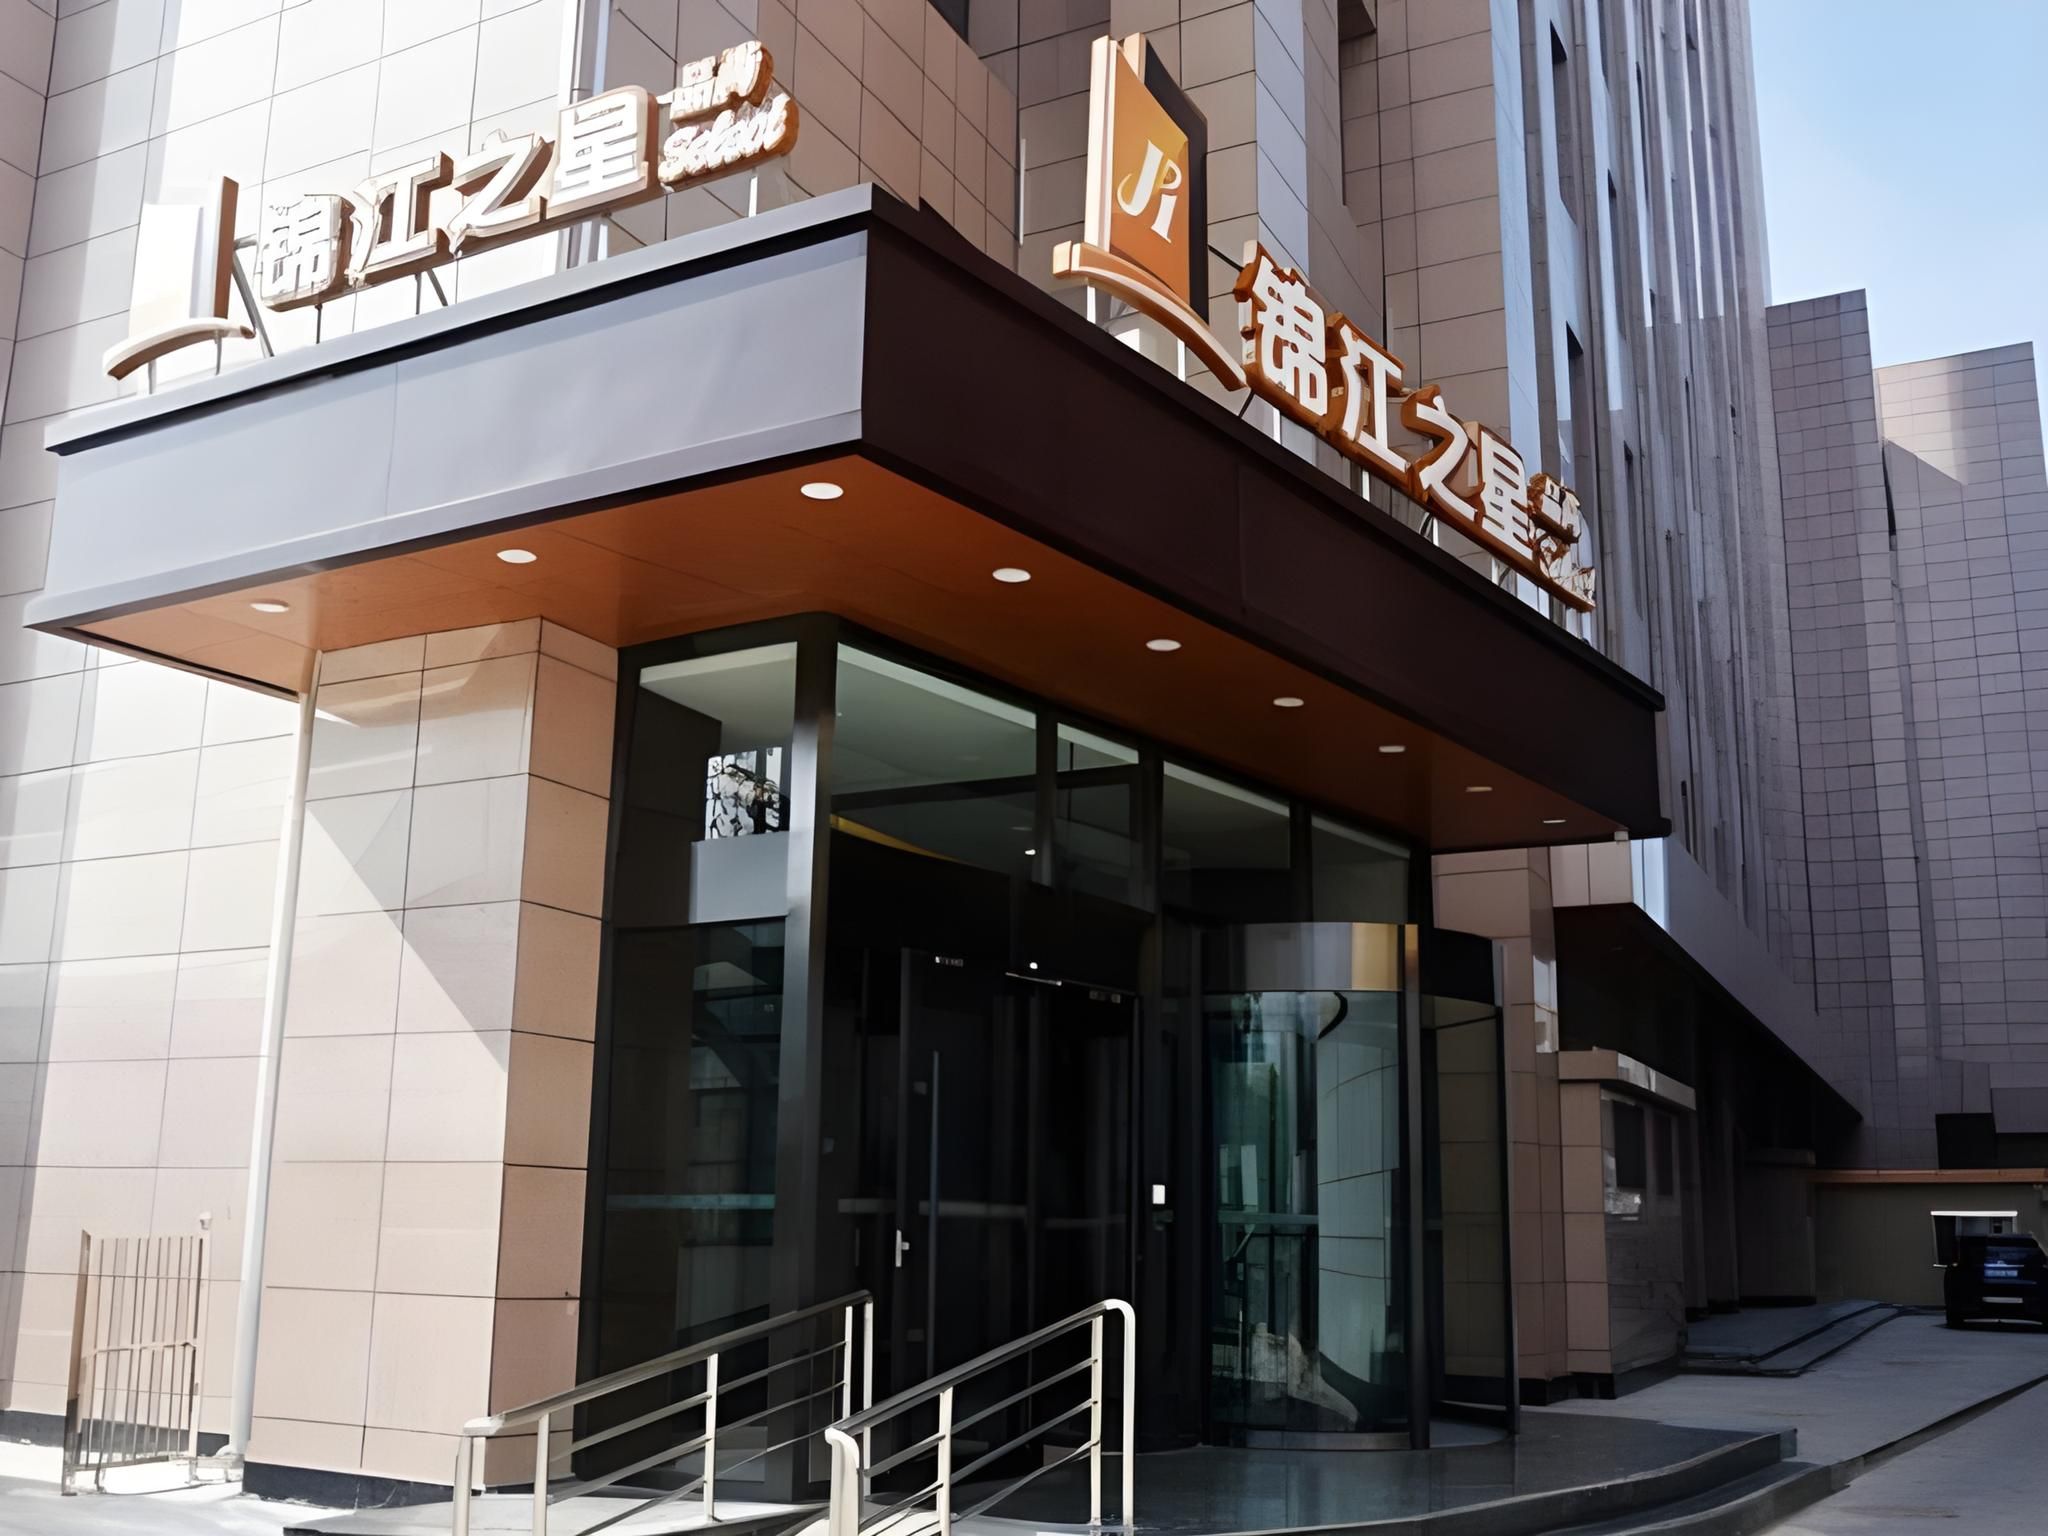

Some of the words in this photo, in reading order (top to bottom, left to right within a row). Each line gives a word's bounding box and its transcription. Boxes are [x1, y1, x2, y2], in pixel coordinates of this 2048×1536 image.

[262, 86, 650, 303] 锦江之星
[1251, 253, 1535, 561] 锦江之星
